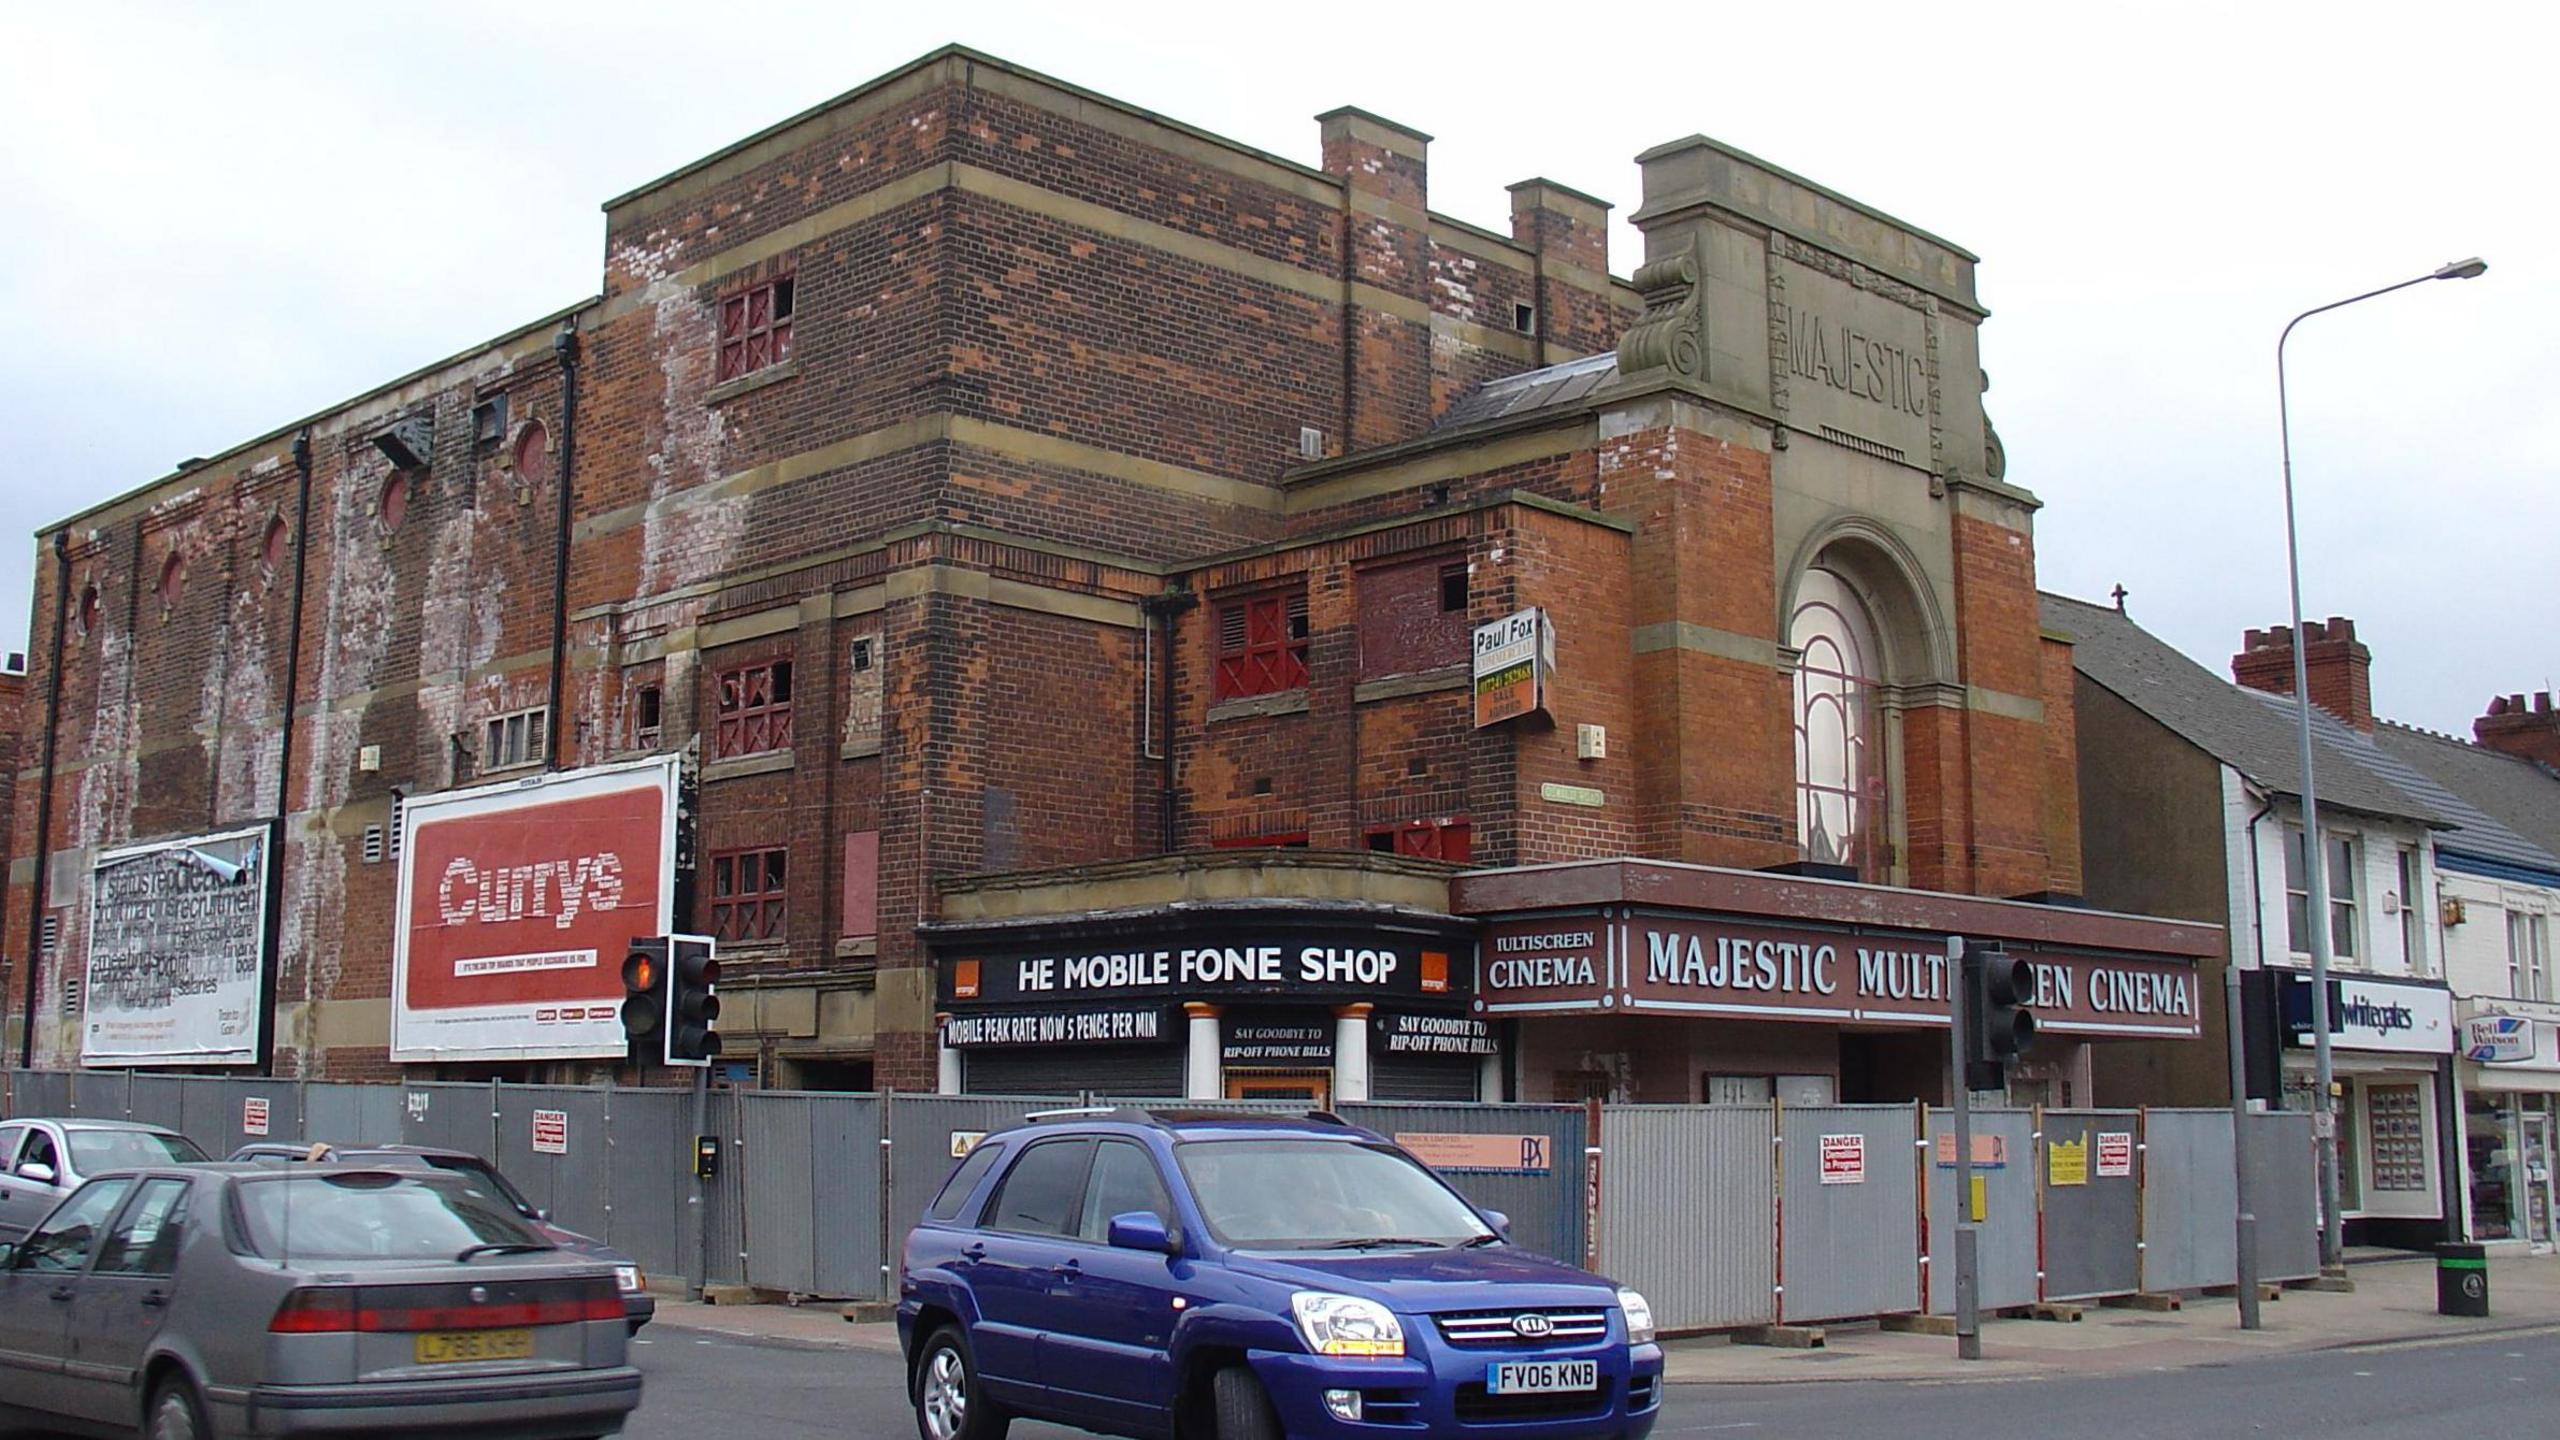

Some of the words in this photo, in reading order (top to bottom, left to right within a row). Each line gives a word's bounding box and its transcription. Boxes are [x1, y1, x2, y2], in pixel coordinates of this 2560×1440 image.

[1788, 305, 1926, 418] MAJESTIC
[1476, 623, 1505, 655] Paul
[1510, 617, 1534, 642] Fox
[439, 852, 624, 929] Currys
[1018, 959, 1054, 992] HE
[1064, 951, 1170, 989] MOBILE
[1180, 947, 1281, 983] FONE
[1300, 948, 1397, 984] SHOP
[1489, 956, 1596, 989] CINEMA
[1647, 931, 1837, 995] MAJESTIC
[2089, 968, 2190, 1016] CINEMA
[1399, 1015, 1420, 1033] SAY
[1421, 1017, 1472, 1035] GOODBYE
[1472, 1020, 1488, 1036] TO
[2343, 995, 2412, 1037] whitegates
[948, 1018, 983, 1045] MOBILE
[985, 1017, 1010, 1044] PEAK
[1012, 1016, 1037, 1042] RATE
[1040, 1015, 1065, 1042] NOW
[1068, 1020, 1075, 1040] 5
[1077, 1013, 1110, 1040] PENCE
[1112, 1012, 1134, 1039] PER
[1136, 1010, 1158, 1038] MIN
[1234, 1028, 1254, 1040] SAY
[1256, 1028, 1306, 1040] GOODBYE
[1307, 1028, 1323, 1040] TO
[2471, 1023, 2498, 1034] Bell
[1390, 1034, 1432, 1051] RIP-OFF
[1432, 1036, 1470, 1053] PHONE
[1470, 1038, 1499, 1054] BILLS
[2471, 1034, 2519, 1045] Watson
[1224, 1046, 1263, 1058] RIP-OFF
[1265, 1046, 1301, 1058] PHONE
[1303, 1045, 1331, 1057] BILLS
[535, 1111, 564, 1121] DANGER
[1823, 1136, 1861, 1147] DANGER
[2100, 1135, 2128, 1143] DANGER
[1520, 1319, 1548, 1332] KIA
[1501, 1365, 1553, 1388] FV06
[1558, 1364, 1594, 1386] KNB
